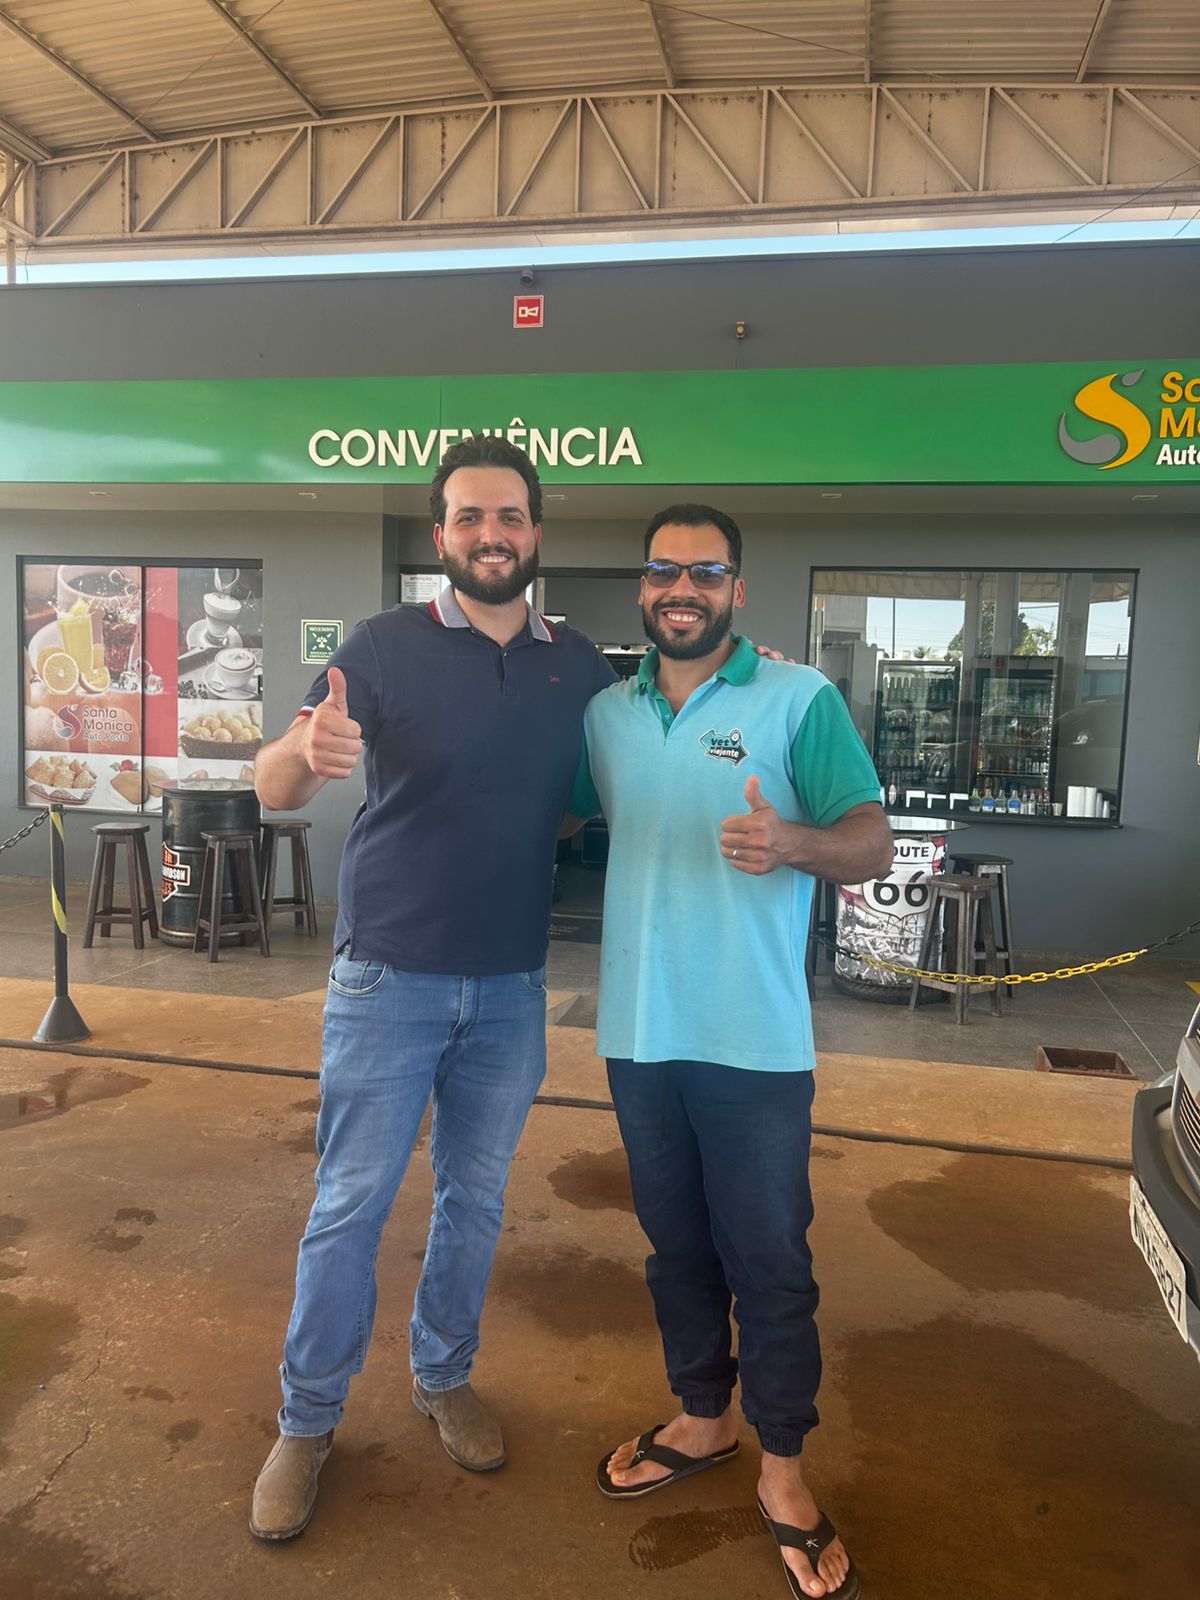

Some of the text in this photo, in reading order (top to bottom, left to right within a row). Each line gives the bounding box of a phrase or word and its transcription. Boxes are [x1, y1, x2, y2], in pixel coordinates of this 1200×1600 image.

[1159, 407, 1200, 438] M
[308, 417, 643, 467] CONVEÊNCIA
[1155, 444, 1200, 466] Aut
[83, 707, 117, 718] Santa
[83, 719, 133, 731] Monica
[84, 732, 129, 741] Auto Posto
[872, 870, 929, 907] 66
